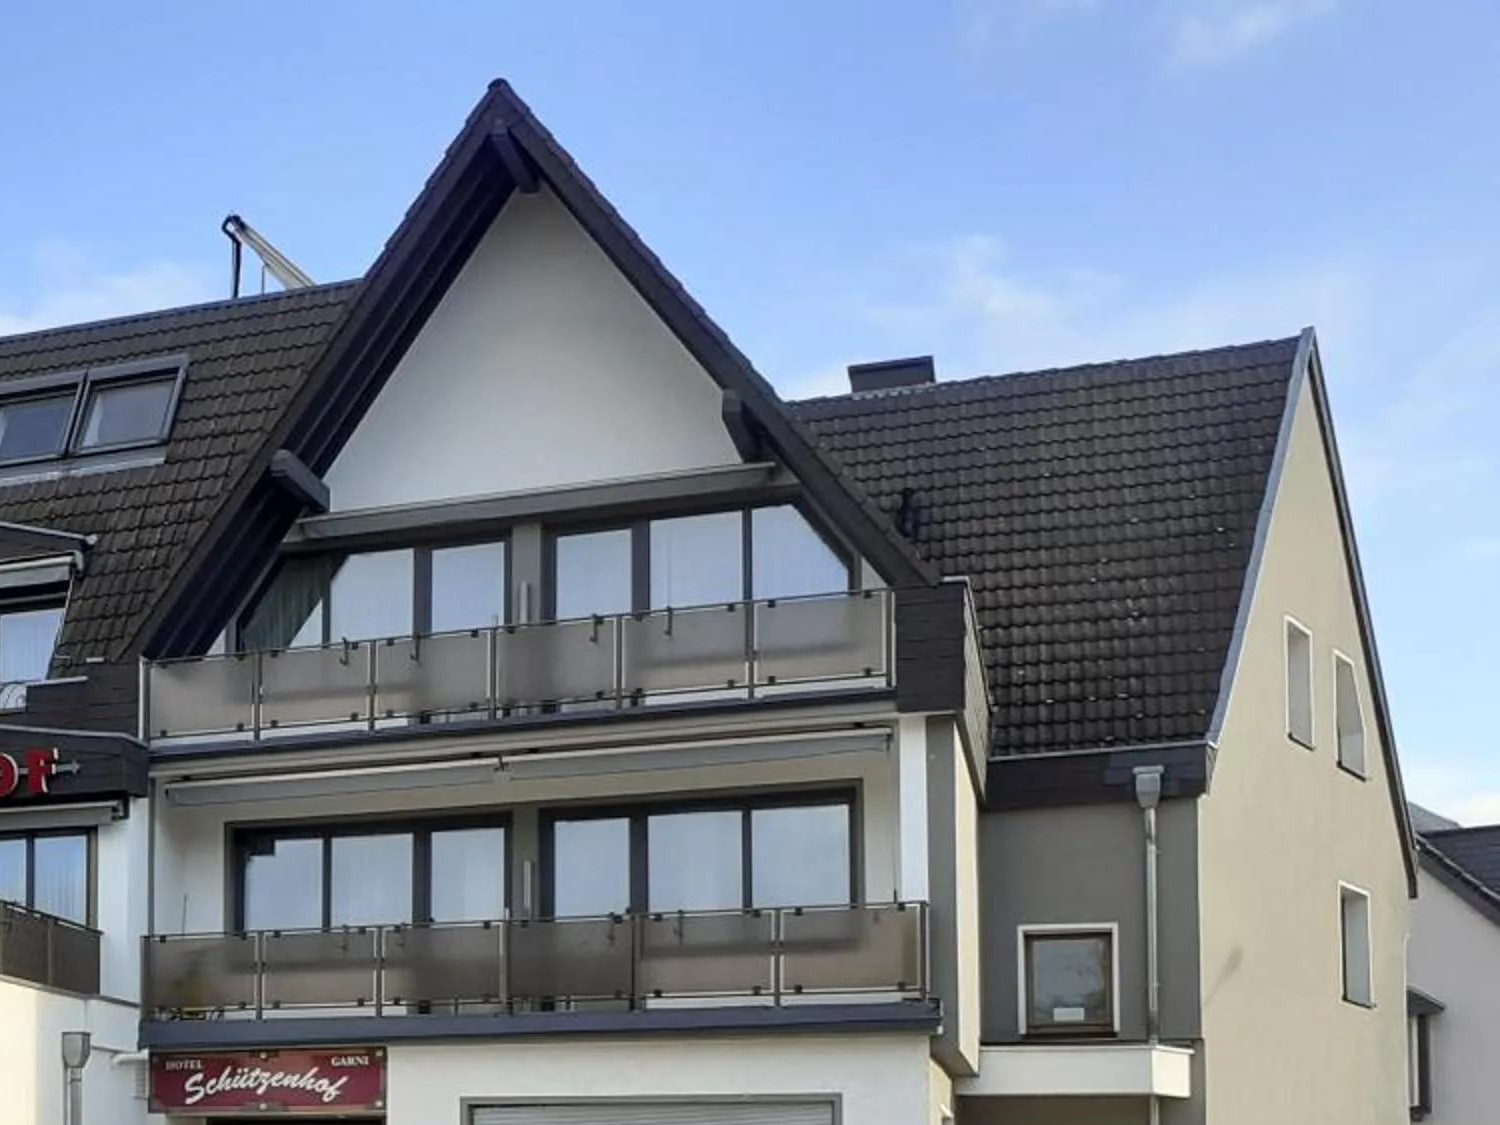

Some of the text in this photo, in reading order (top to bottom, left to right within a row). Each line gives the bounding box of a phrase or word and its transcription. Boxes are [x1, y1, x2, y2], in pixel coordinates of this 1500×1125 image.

[165, 1055, 369, 1071] HOTEL GARNI
[184, 1066, 349, 1105] Schützenhof
